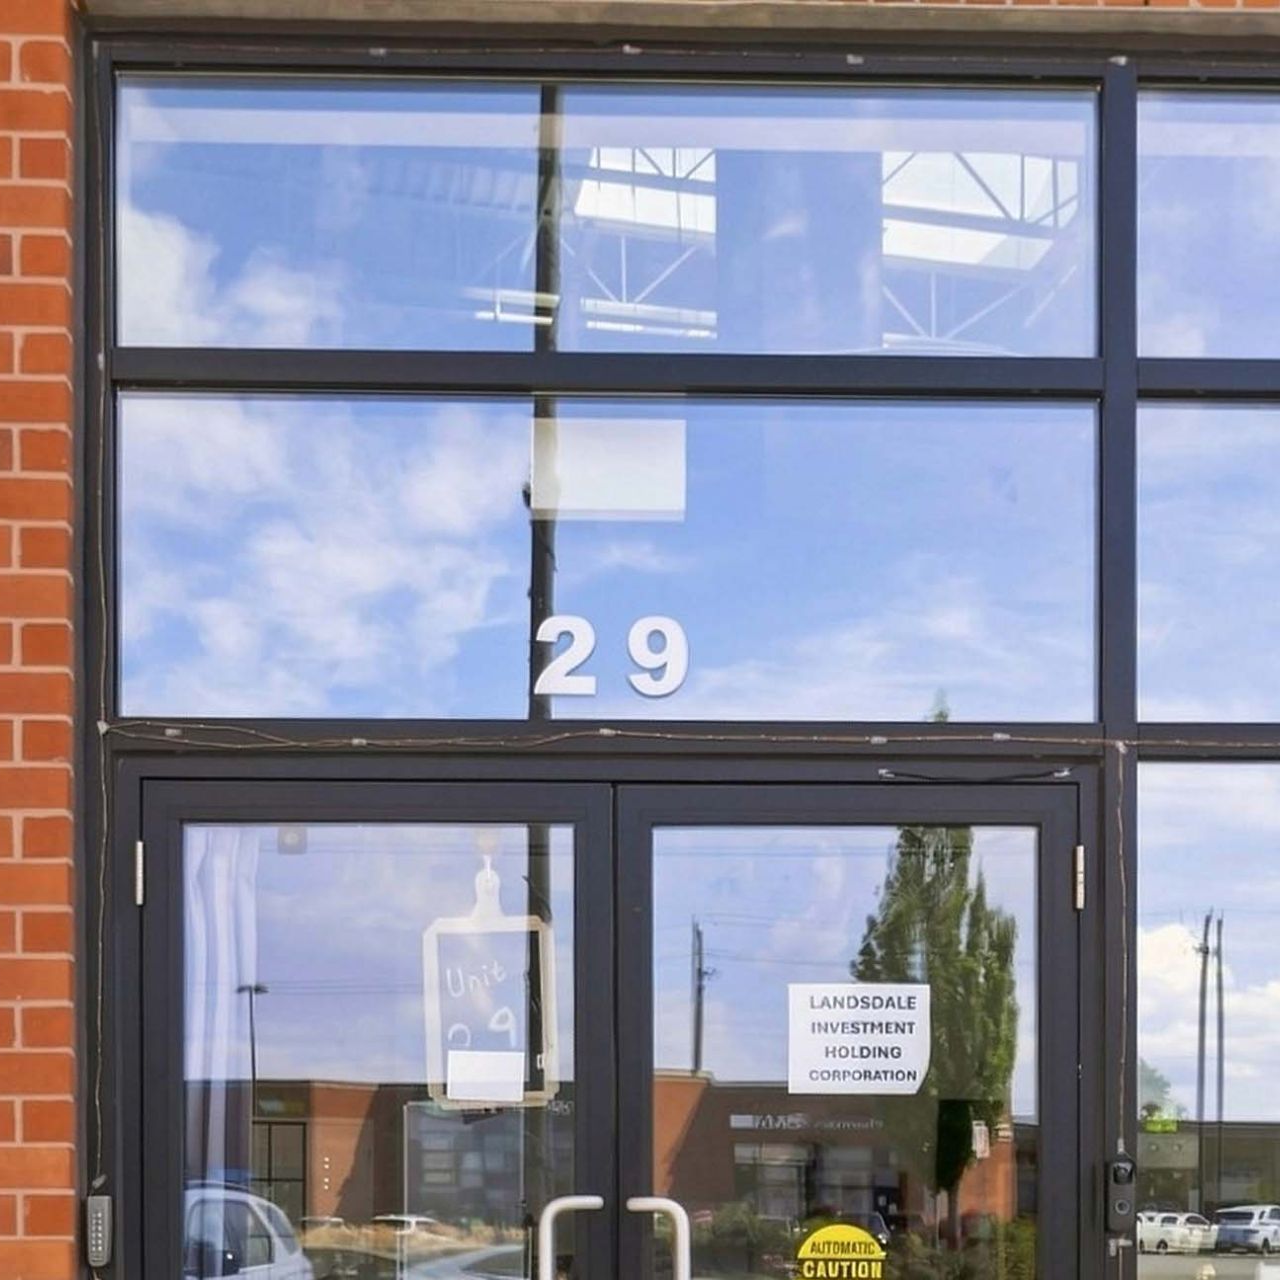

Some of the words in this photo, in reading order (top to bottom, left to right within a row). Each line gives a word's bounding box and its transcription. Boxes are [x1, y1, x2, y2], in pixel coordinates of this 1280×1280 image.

[534, 615, 688, 698] 29
[446, 962, 507, 998] Unit
[809, 995, 918, 1010] LANDSDALE
[810, 1021, 916, 1035] INVESTMENT
[824, 1045, 903, 1060] HOLDING
[808, 1068, 918, 1082] CORPORATION
[809, 1240, 876, 1254] AUTOMATIC
[802, 1260, 883, 1279] CAUTION
